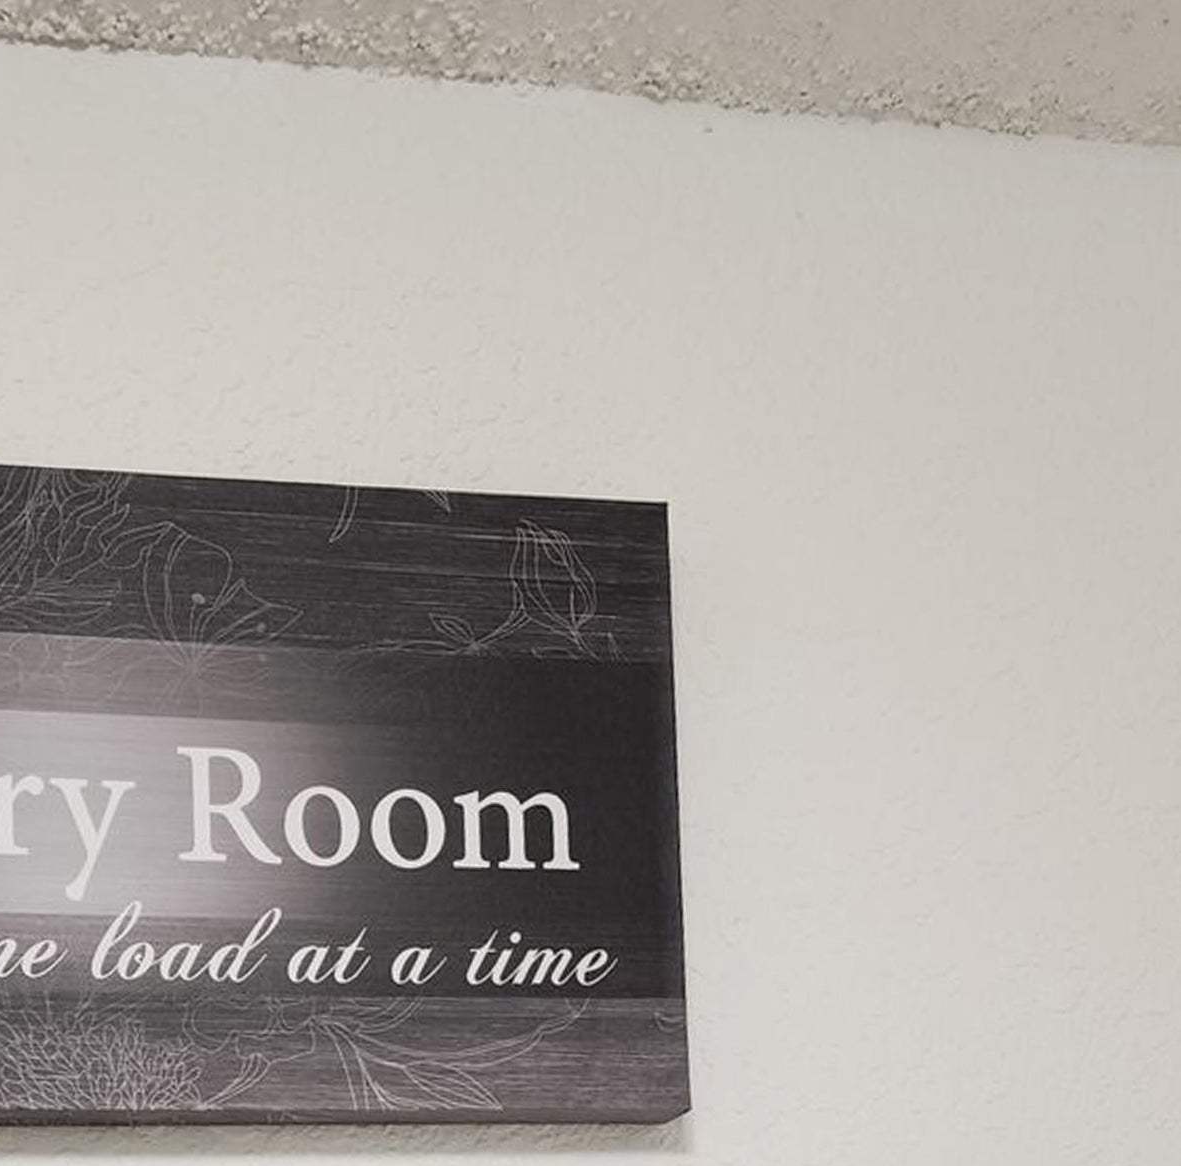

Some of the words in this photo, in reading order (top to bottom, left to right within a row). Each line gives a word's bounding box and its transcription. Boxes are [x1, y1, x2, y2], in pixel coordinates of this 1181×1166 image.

[177, 746, 580, 871] Room
[90, 900, 282, 984] load
[287, 927, 372, 985] at
[390, 942, 446, 986] a
[466, 929, 618, 986] time
